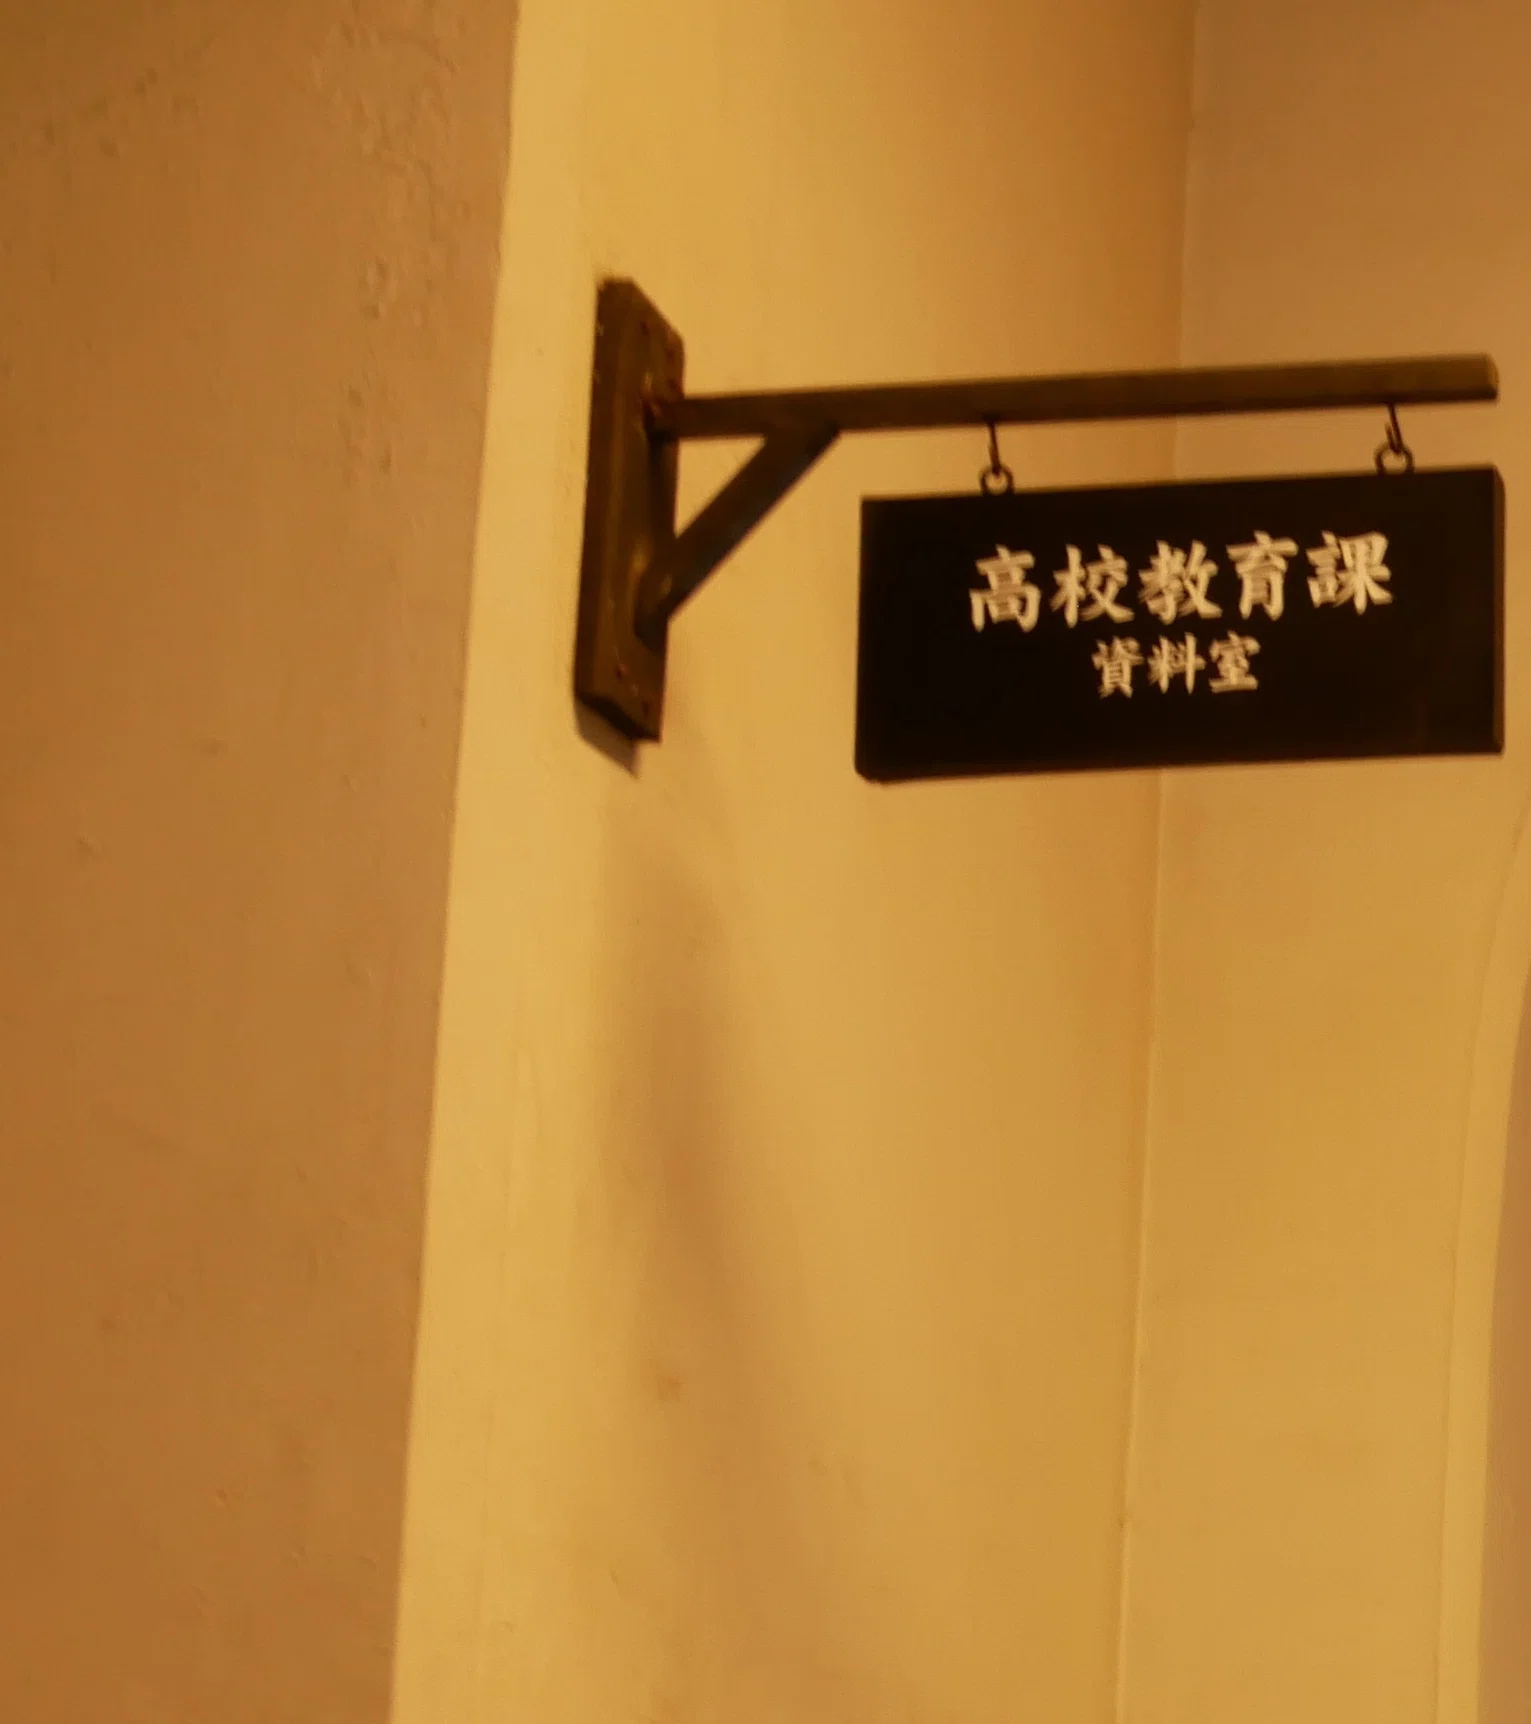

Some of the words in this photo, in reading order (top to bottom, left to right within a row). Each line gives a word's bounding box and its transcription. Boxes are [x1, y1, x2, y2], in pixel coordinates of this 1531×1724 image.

[969, 531, 1393, 632] 高校教育課
[1093, 631, 1261, 697] 資料室
